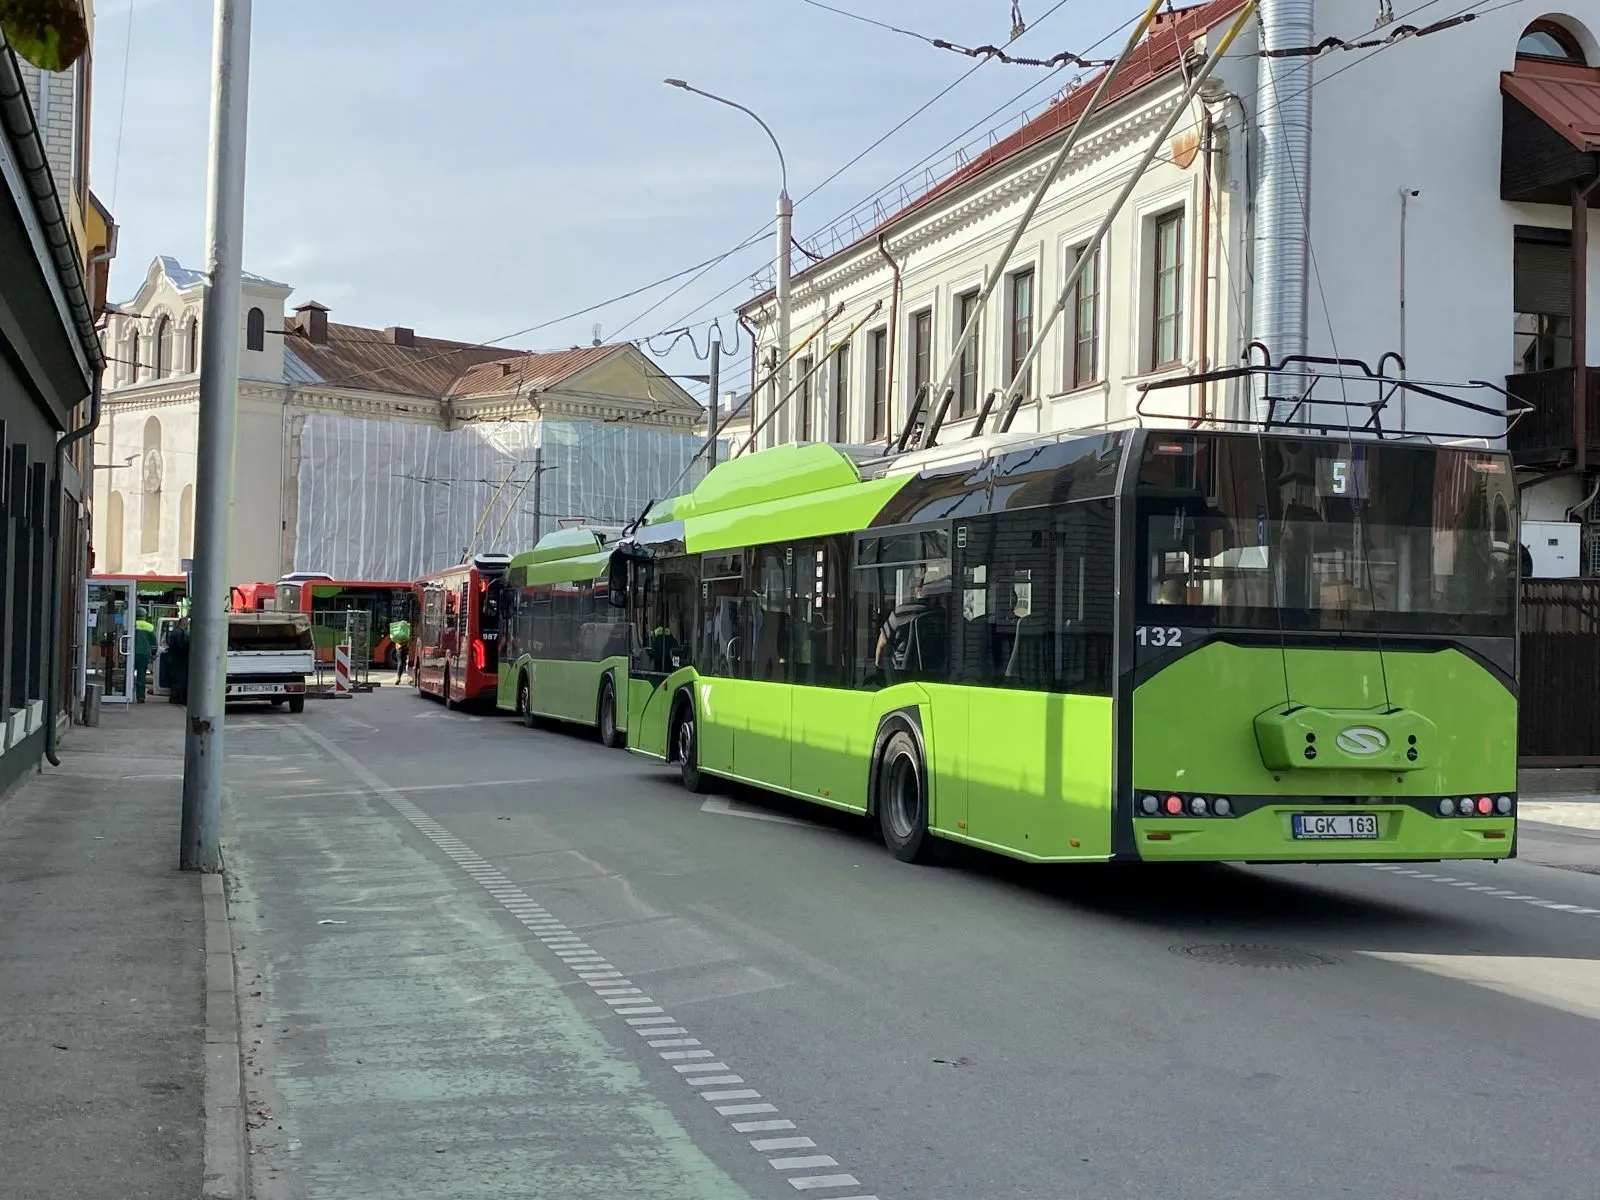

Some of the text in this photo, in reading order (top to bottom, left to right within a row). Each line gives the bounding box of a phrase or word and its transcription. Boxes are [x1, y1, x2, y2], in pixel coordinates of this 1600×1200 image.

[1332, 462, 1347, 493] 5
[1135, 626, 1182, 647] 132
[1303, 817, 1375, 833] LGK 163
